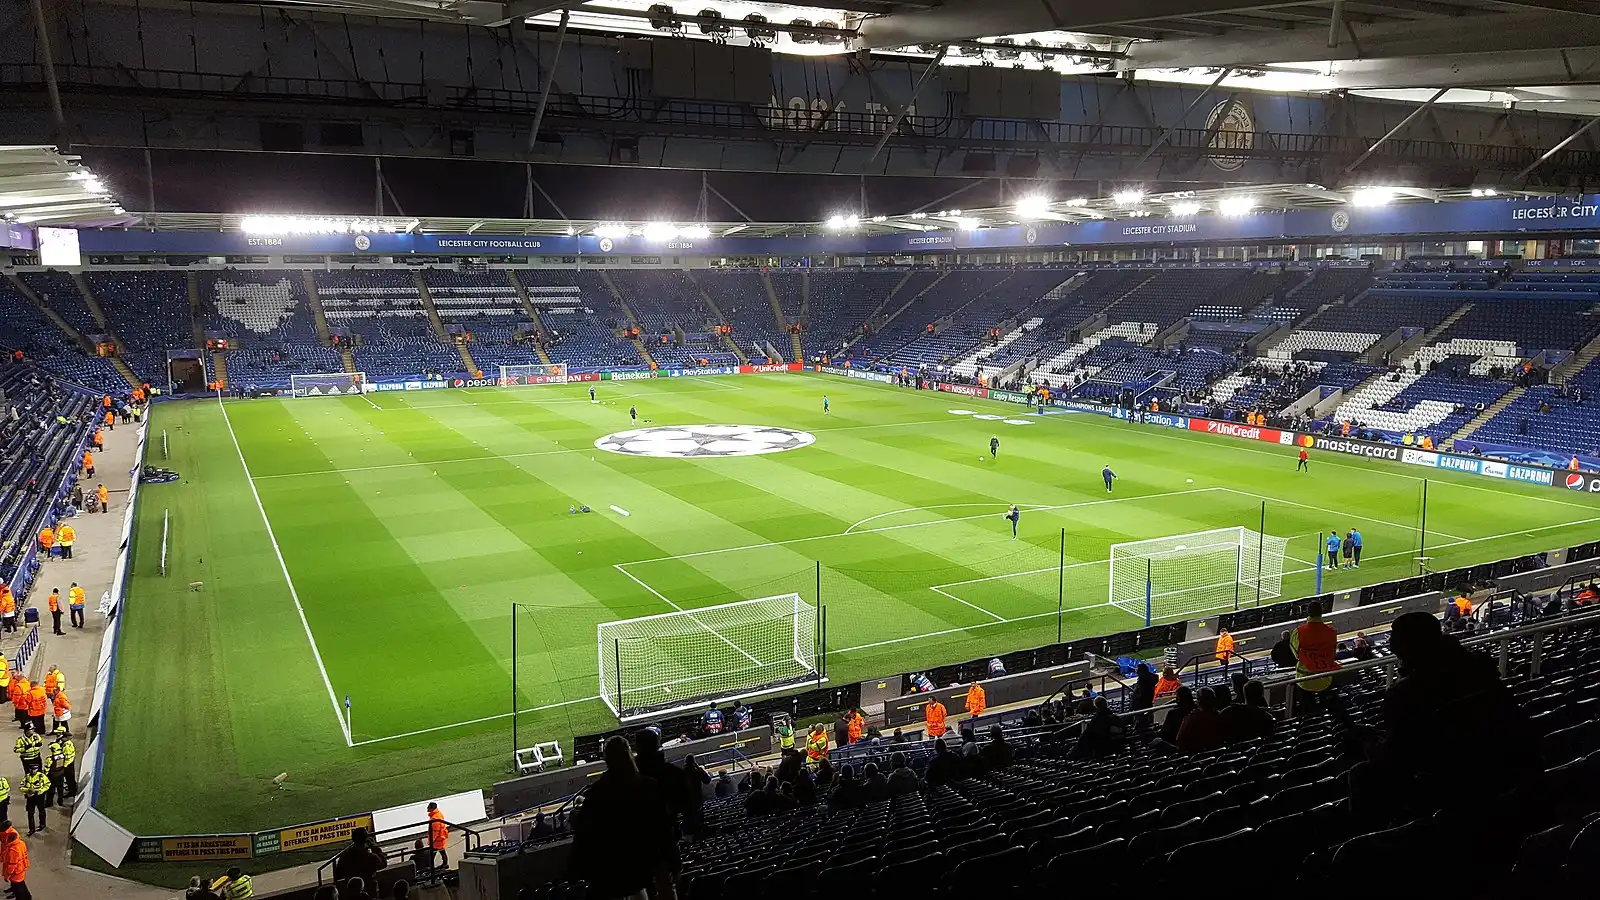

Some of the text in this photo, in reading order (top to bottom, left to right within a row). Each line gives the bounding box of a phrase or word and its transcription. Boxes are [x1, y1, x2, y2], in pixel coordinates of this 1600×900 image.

[1571, 205, 1598, 217] CITY
[1122, 224, 1197, 235] LEICESTER CITY STADIUM
[489, 240, 523, 248] FOOTBALL
[682, 367, 721, 376] PlayStation
[759, 363, 789, 372] UniCredit
[821, 366, 848, 376] mastercard
[546, 374, 581, 384] NISSAN
[611, 371, 650, 380] Heineken
[467, 377, 495, 387] pepsi
[951, 385, 975, 396] NISSAN
[993, 391, 1008, 402] Enjoy
[1066, 401, 1095, 411] CHAMPIONS
[1217, 423, 1260, 439] UniCredit
[1316, 438, 1398, 460] mastercard
[1440, 456, 1478, 472] GAZPROM
[1509, 469, 1551, 484] GAZPROM
[320, 821, 357, 832] ARRESTABLE
[201, 840, 236, 848] ARRESTABLE
[284, 837, 309, 847] OFFENCE
[319, 832, 335, 841] PASS
[336, 830, 350, 838] THIS
